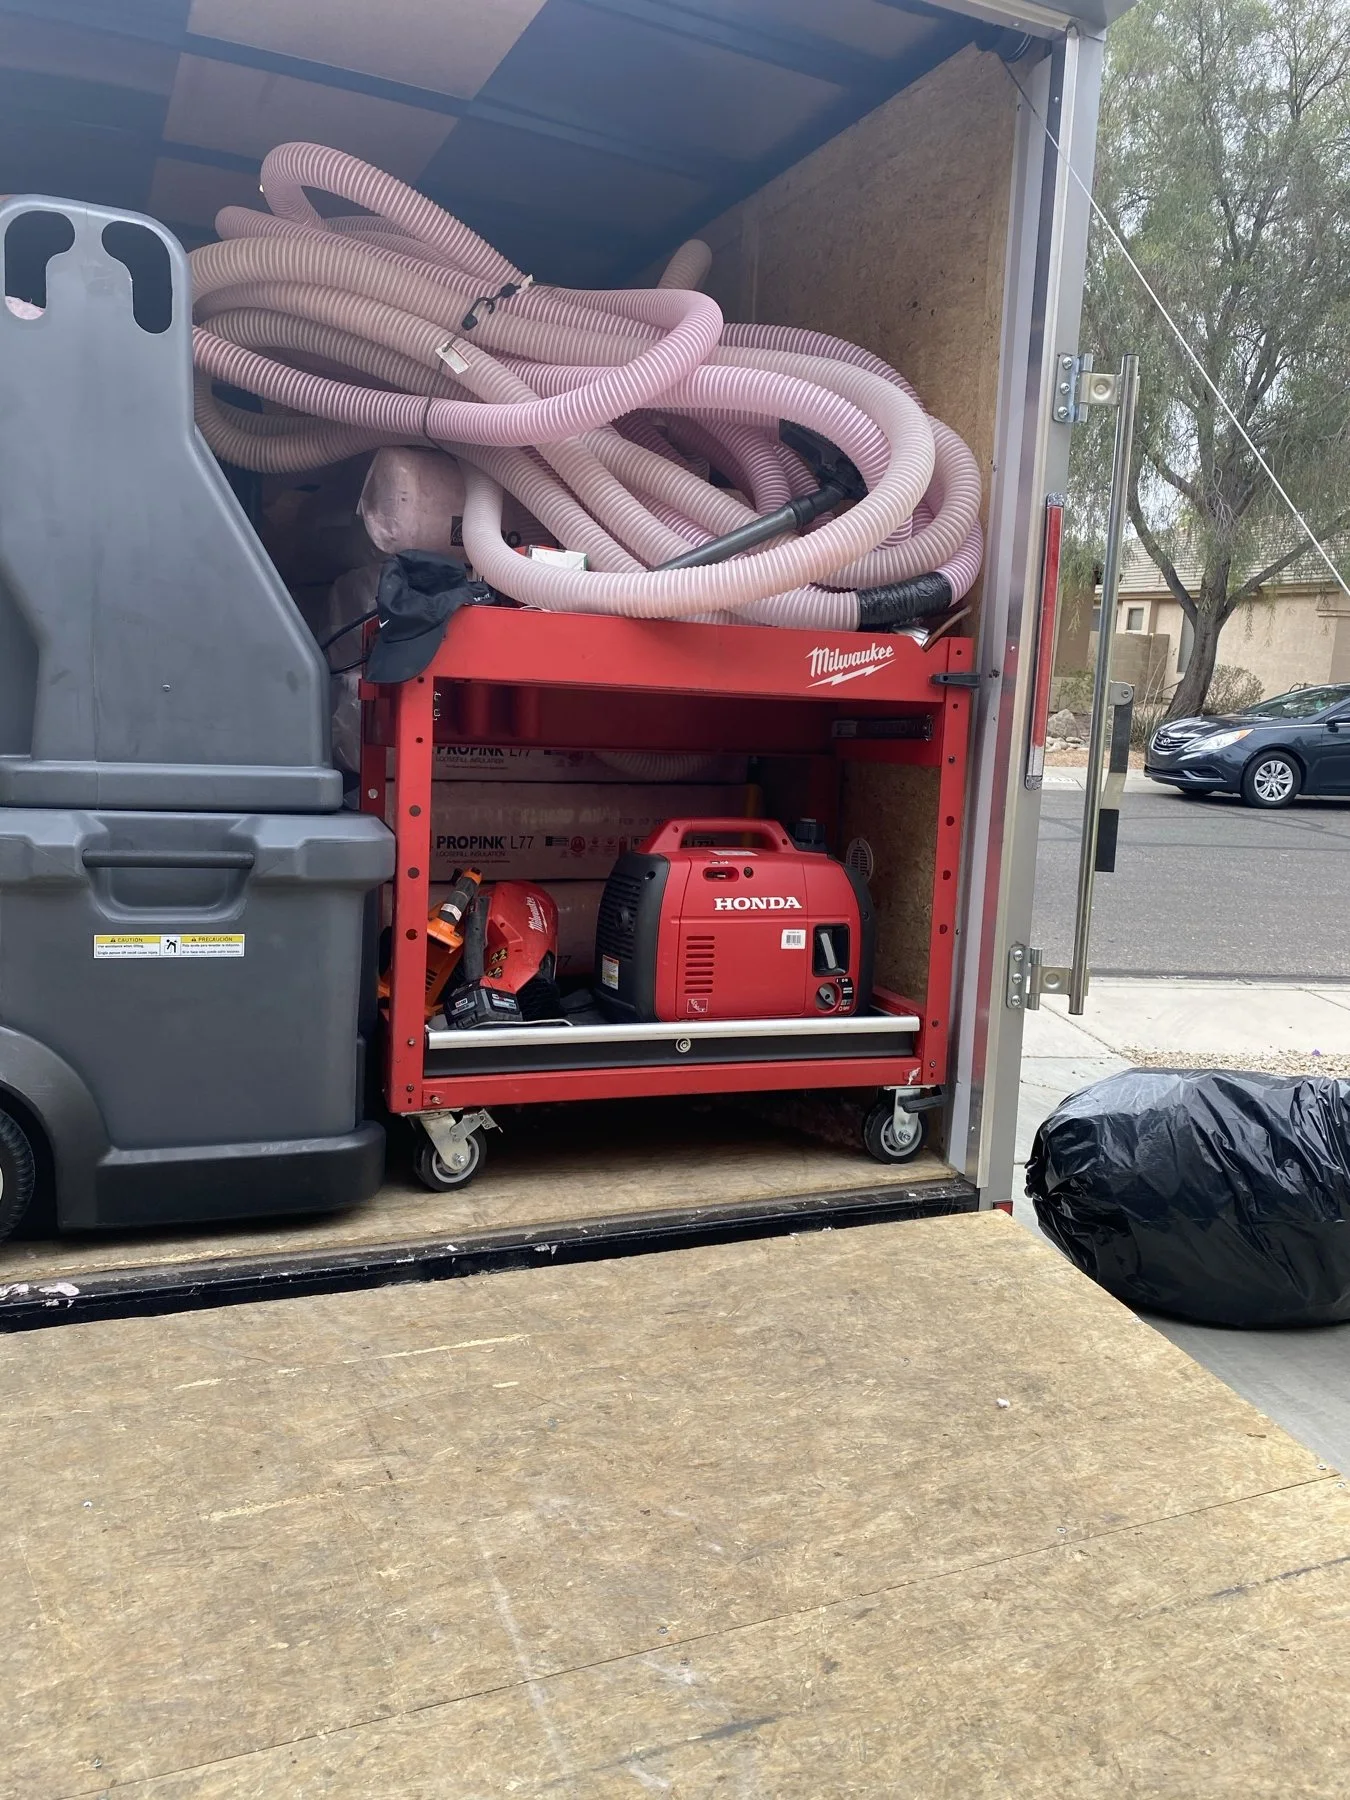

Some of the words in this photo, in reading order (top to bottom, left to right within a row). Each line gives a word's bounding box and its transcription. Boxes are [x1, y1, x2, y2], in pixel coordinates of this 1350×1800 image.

[805, 642, 894, 678] Milwaukee
[436, 835, 504, 849] PROPINK
[510, 835, 535, 849] L77
[714, 896, 802, 911] HONDA
